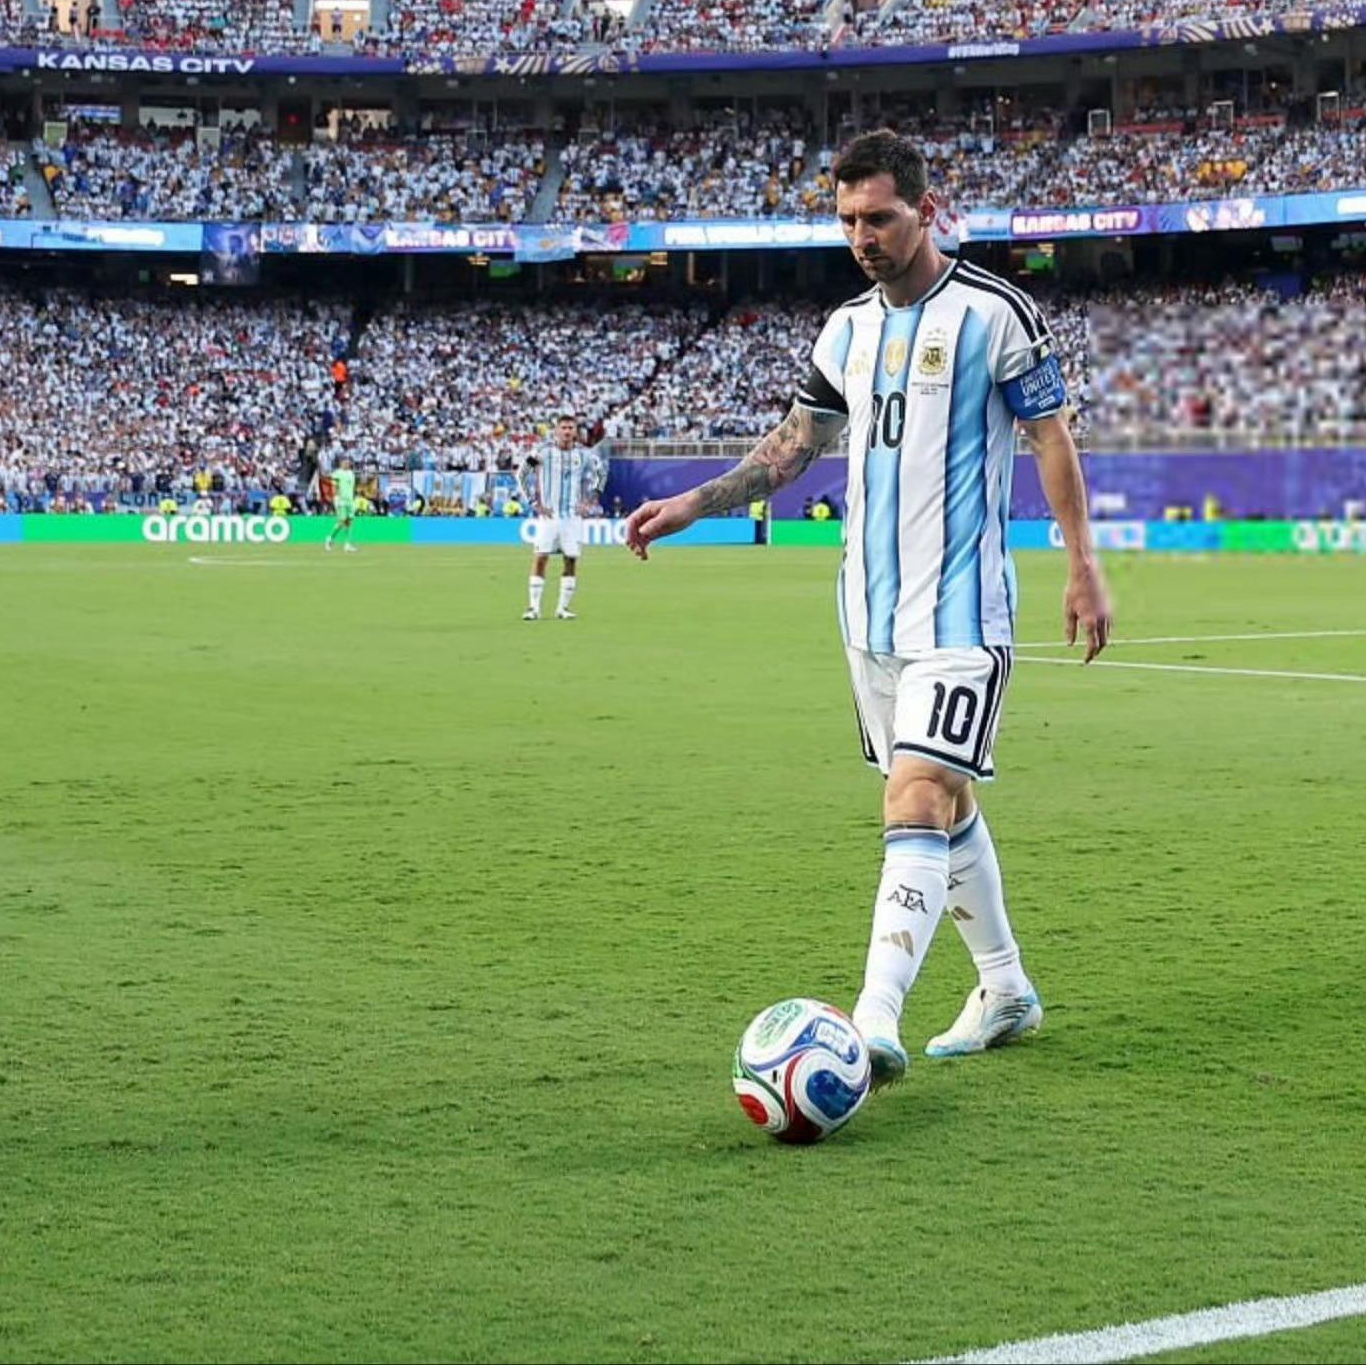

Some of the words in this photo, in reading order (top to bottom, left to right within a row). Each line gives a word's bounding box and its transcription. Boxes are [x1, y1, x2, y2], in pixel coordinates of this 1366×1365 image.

[38, 52, 174, 72] KANSAS
[180, 56, 254, 74] CITY
[1012, 213, 1092, 234] KANSAS
[1093, 211, 1138, 230] CITY
[869, 391, 906, 449] 10
[142, 514, 291, 542] aramco
[926, 682, 977, 745] 10
[887, 884, 928, 914] AFA
